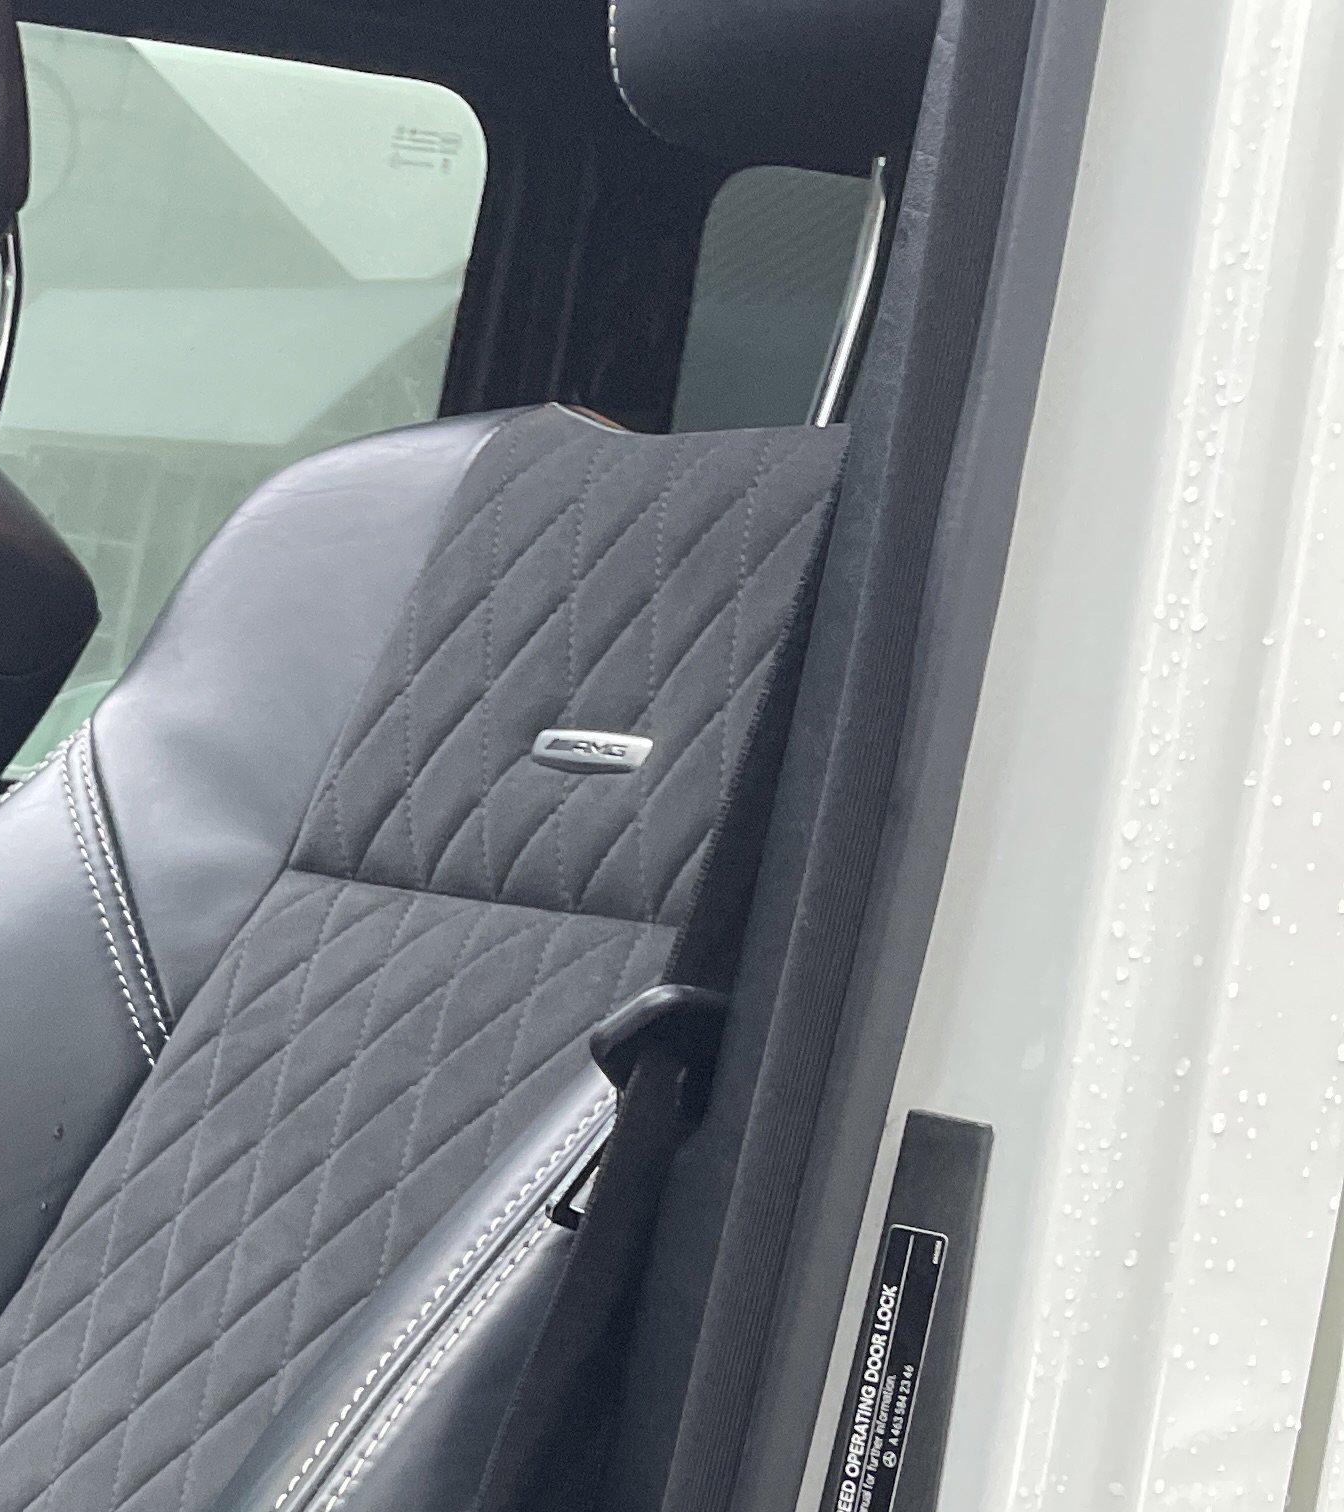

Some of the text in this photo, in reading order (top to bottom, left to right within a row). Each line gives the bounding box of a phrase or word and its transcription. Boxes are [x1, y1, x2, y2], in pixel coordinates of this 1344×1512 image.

[874, 1284, 897, 1331] LOCK
[863, 1333, 887, 1383] DOOR
[845, 1385, 876, 1477] OPERATING
[888, 1437, 899, 1446] A
